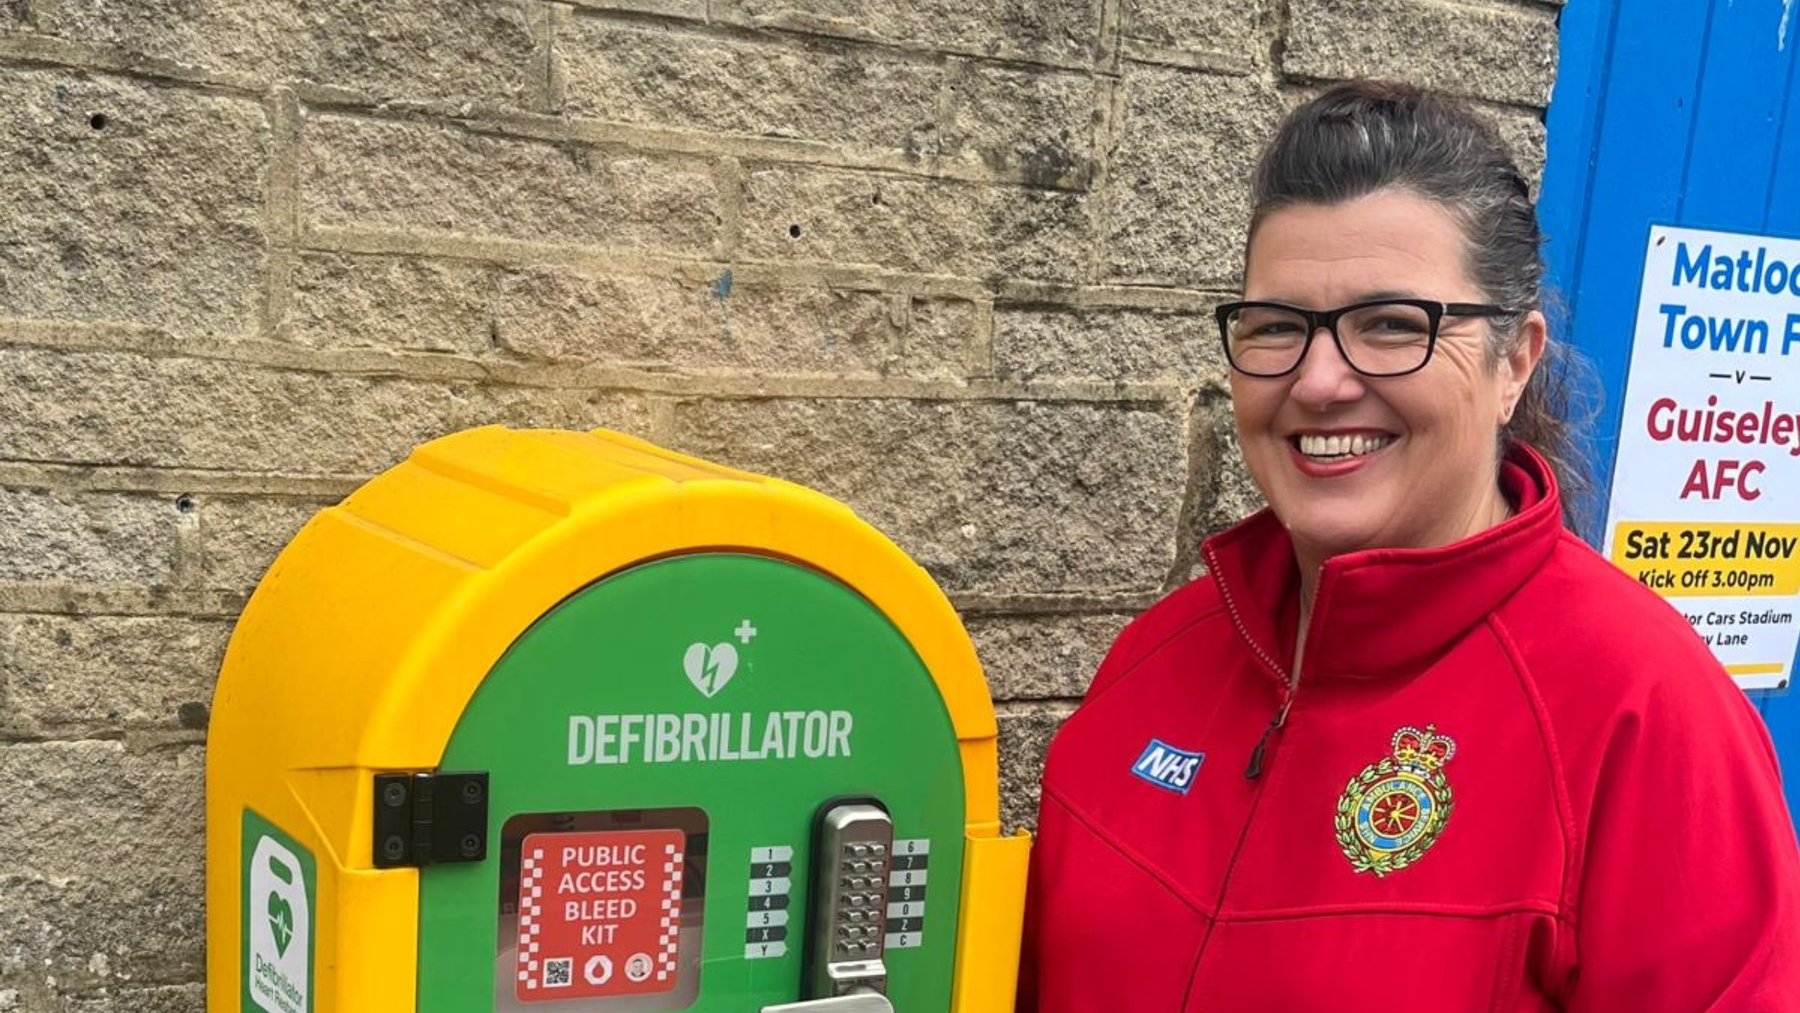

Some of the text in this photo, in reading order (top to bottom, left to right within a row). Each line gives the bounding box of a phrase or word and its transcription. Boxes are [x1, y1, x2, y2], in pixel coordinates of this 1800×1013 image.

[1659, 303, 1769, 354] Town
[1679, 459, 1766, 501] AFC
[1625, 529, 1798, 559] Sat 23rd Nov
[1639, 569, 1774, 591] Kick Off 3.00pm
[1706, 611, 1735, 626] Cars
[1739, 609, 1793, 625] Stadium
[1716, 632, 1748, 646] Lane
[567, 710, 853, 765] DEFIBRILLATOR
[1137, 746, 1199, 787] NHS
[562, 844, 646, 868] PUBLIC
[907, 858, 914, 868] 7
[766, 865, 773, 876] 2
[905, 873, 912, 883] 8
[557, 870, 645, 895] ACCESS
[765, 883, 772, 893] 3
[904, 888, 911, 899] 9
[565, 898, 637, 922] BLEED
[764, 897, 771, 908] 4
[763, 914, 769, 925] 5
[581, 925, 619, 945] KIT
[761, 930, 768, 941] X
[761, 946, 768, 956] Y
